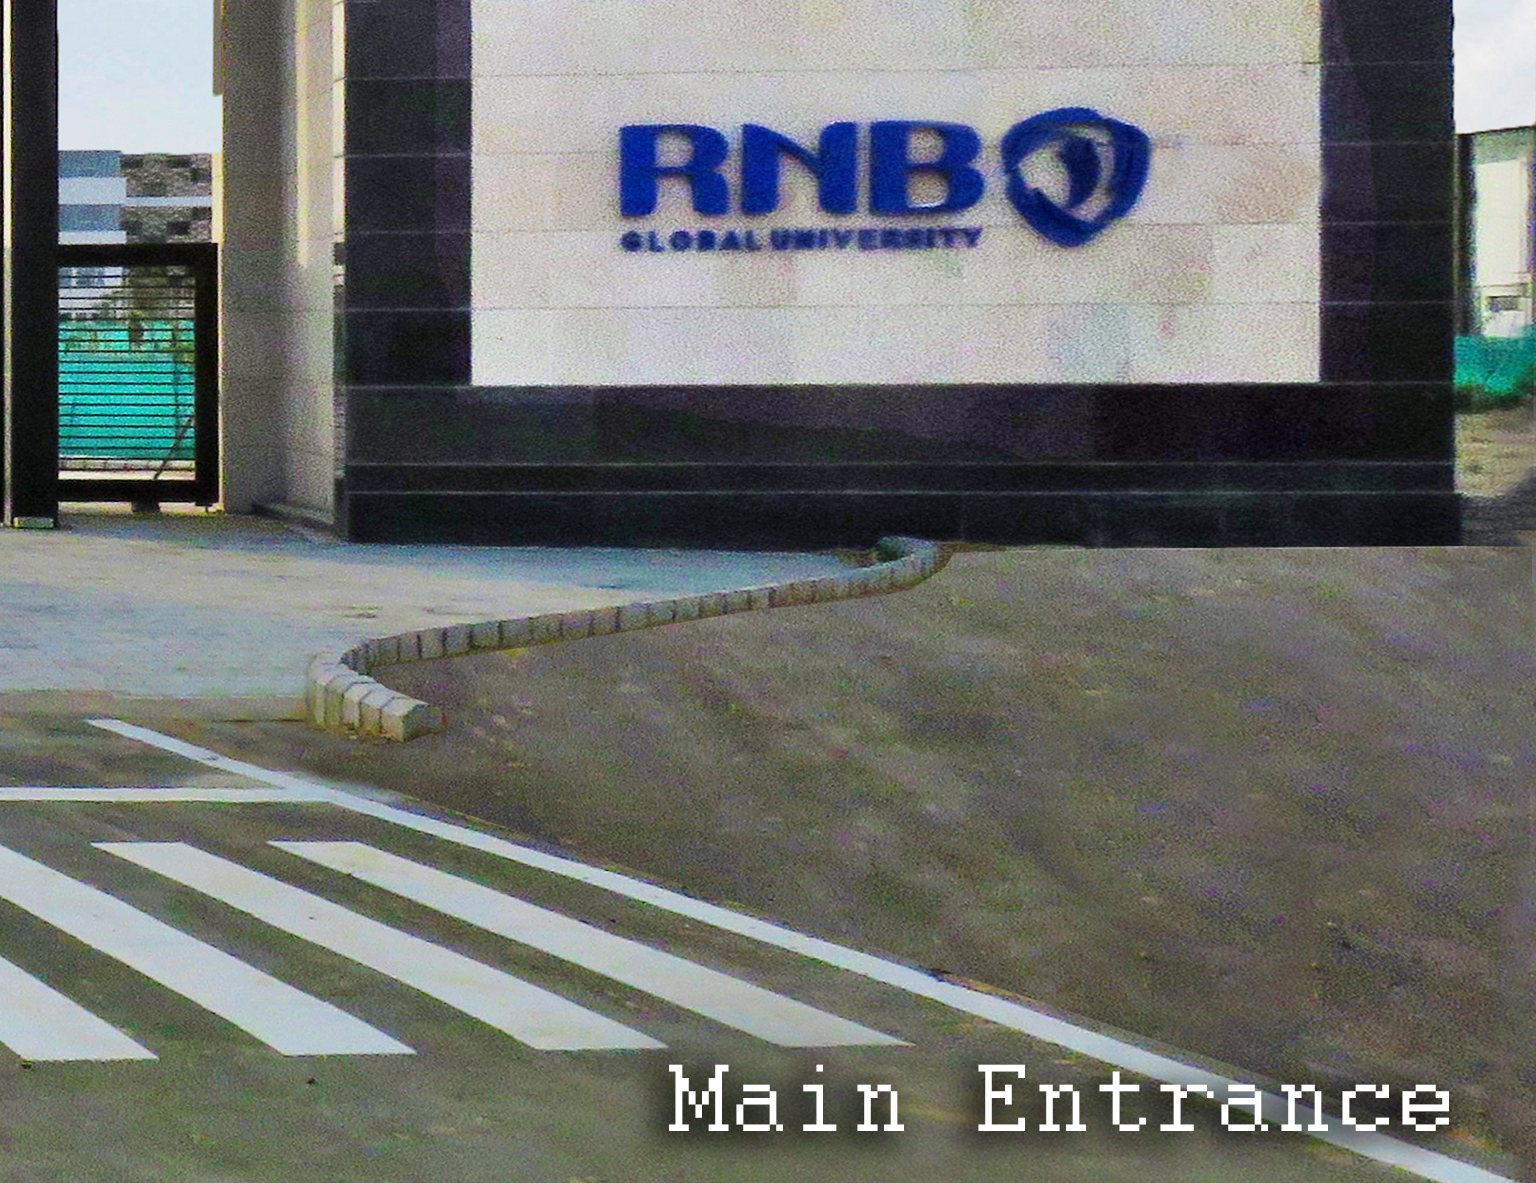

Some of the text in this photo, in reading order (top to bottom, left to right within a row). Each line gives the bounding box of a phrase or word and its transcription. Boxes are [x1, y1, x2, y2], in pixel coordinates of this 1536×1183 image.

[618, 120, 985, 217] RNB
[620, 226, 983, 253] GLOBAL UNIVERSITY
